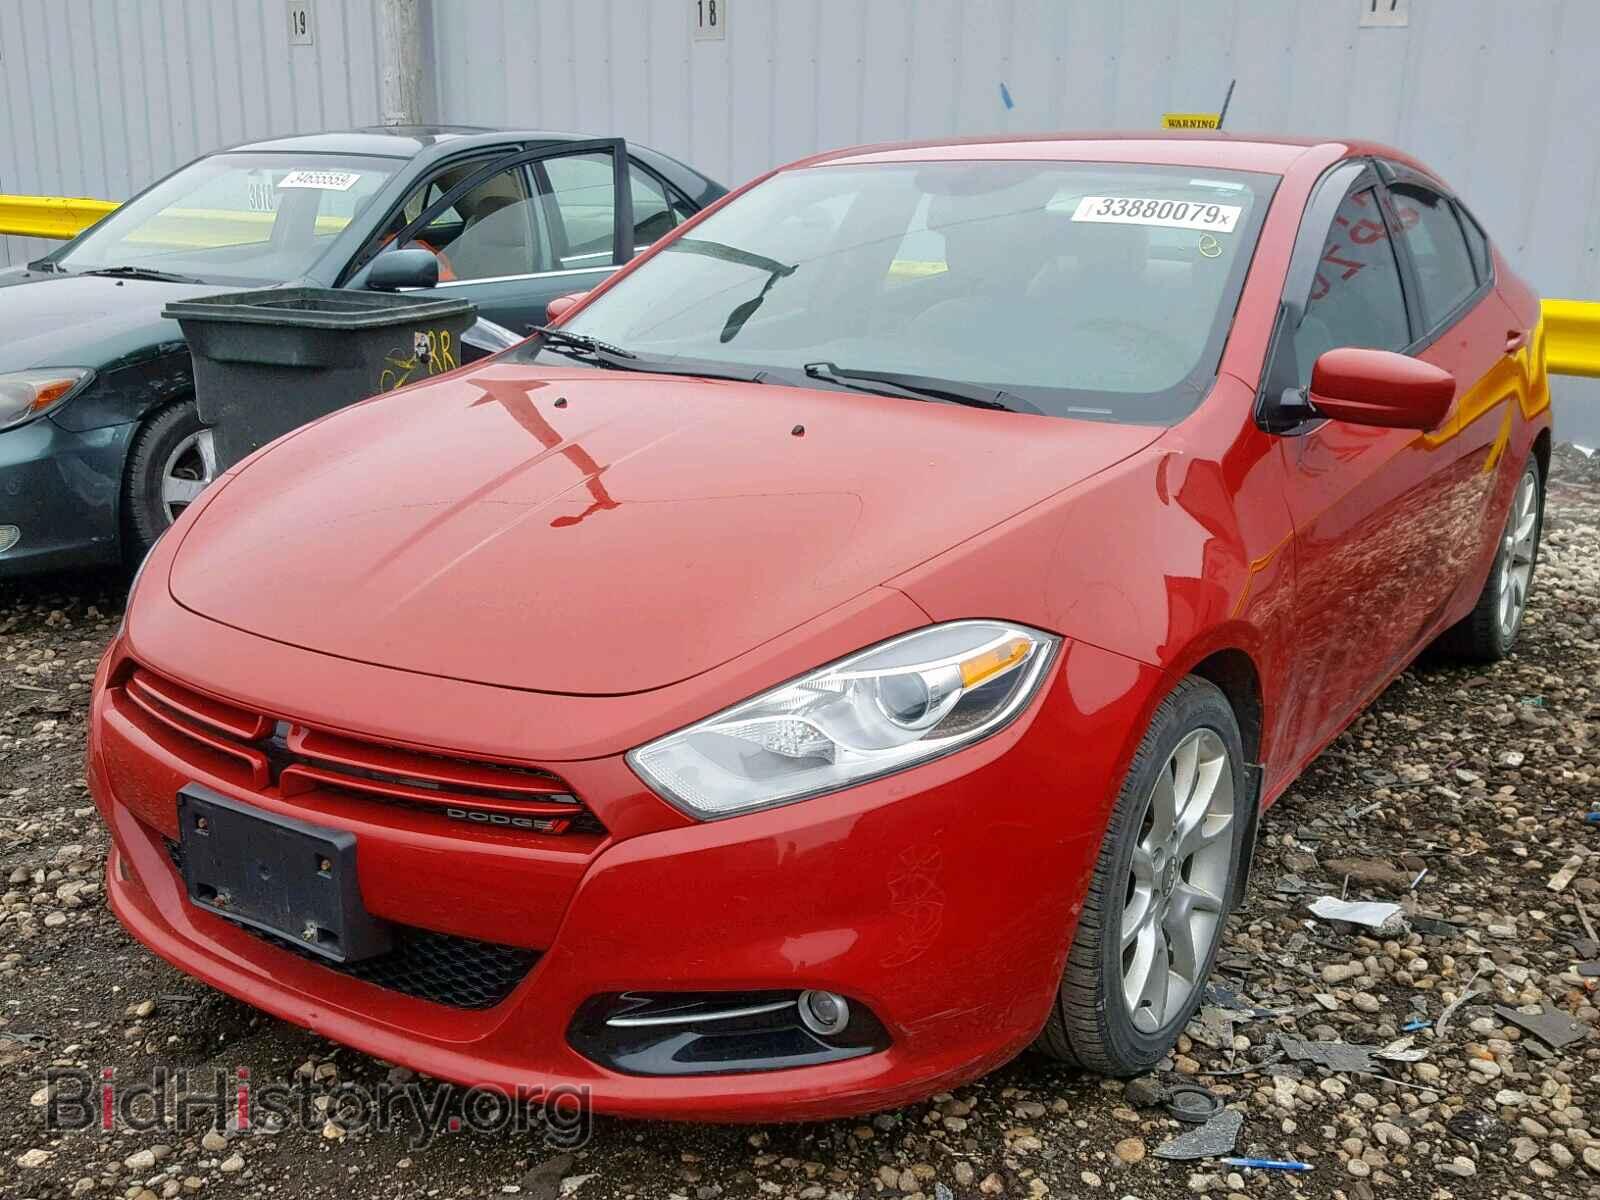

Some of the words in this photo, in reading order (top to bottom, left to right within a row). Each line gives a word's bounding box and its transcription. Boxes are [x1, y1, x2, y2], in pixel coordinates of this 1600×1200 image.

[293, 11, 306, 35] 19
[697, 0, 717, 27] 18
[1167, 119, 1217, 129] WARNING
[447, 808, 554, 831] DODGE
